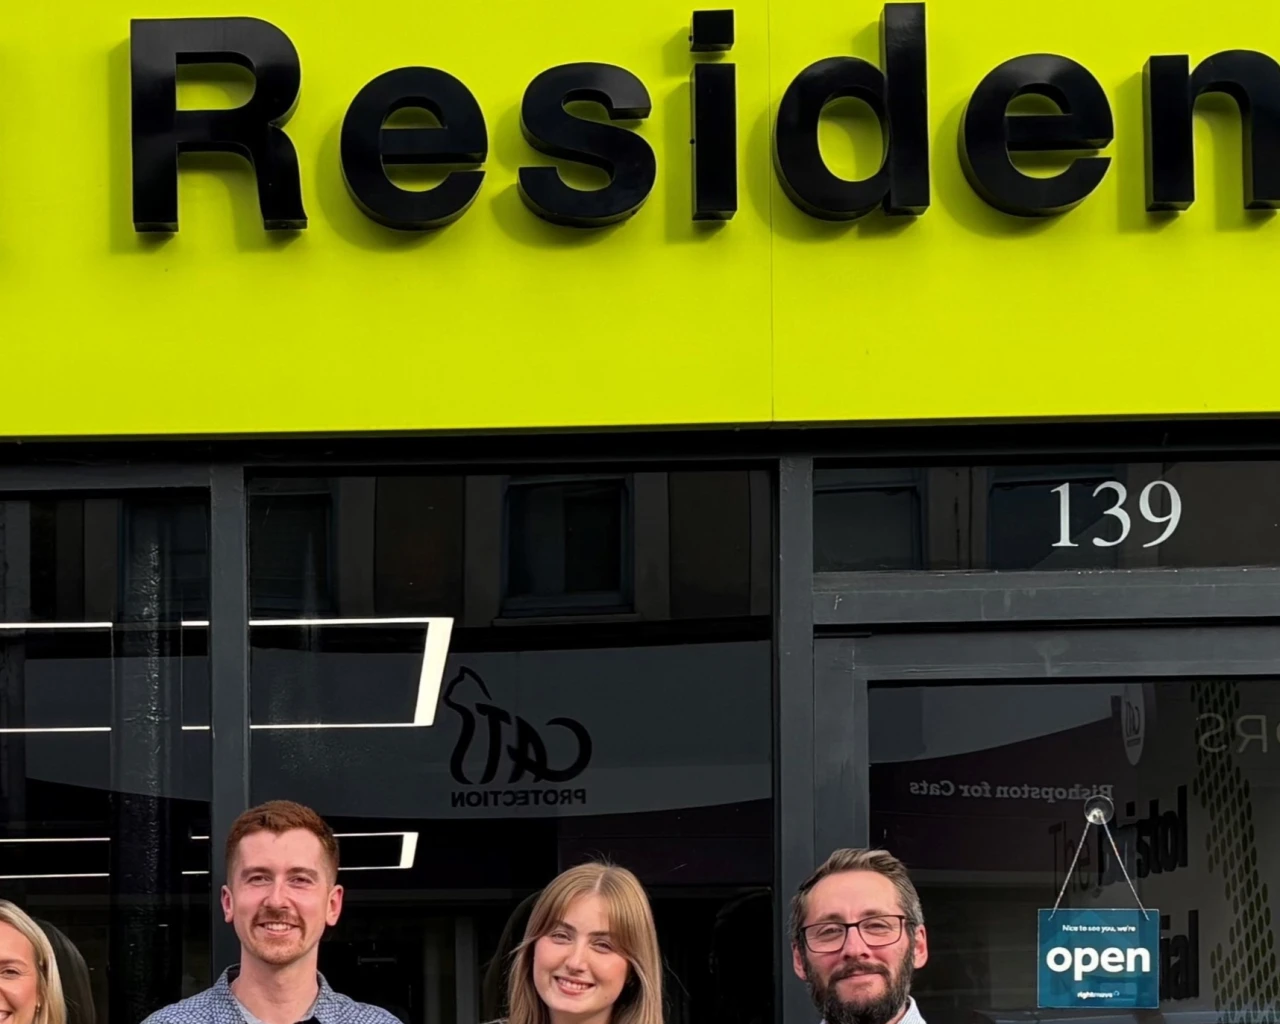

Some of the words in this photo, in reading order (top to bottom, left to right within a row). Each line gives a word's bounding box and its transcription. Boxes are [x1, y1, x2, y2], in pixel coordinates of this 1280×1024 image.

[130, 2, 1280, 232] Residen
[1050, 480, 1182, 548] 139
[1062, 924, 1078, 932] Nice
[1046, 946, 1151, 981] open
